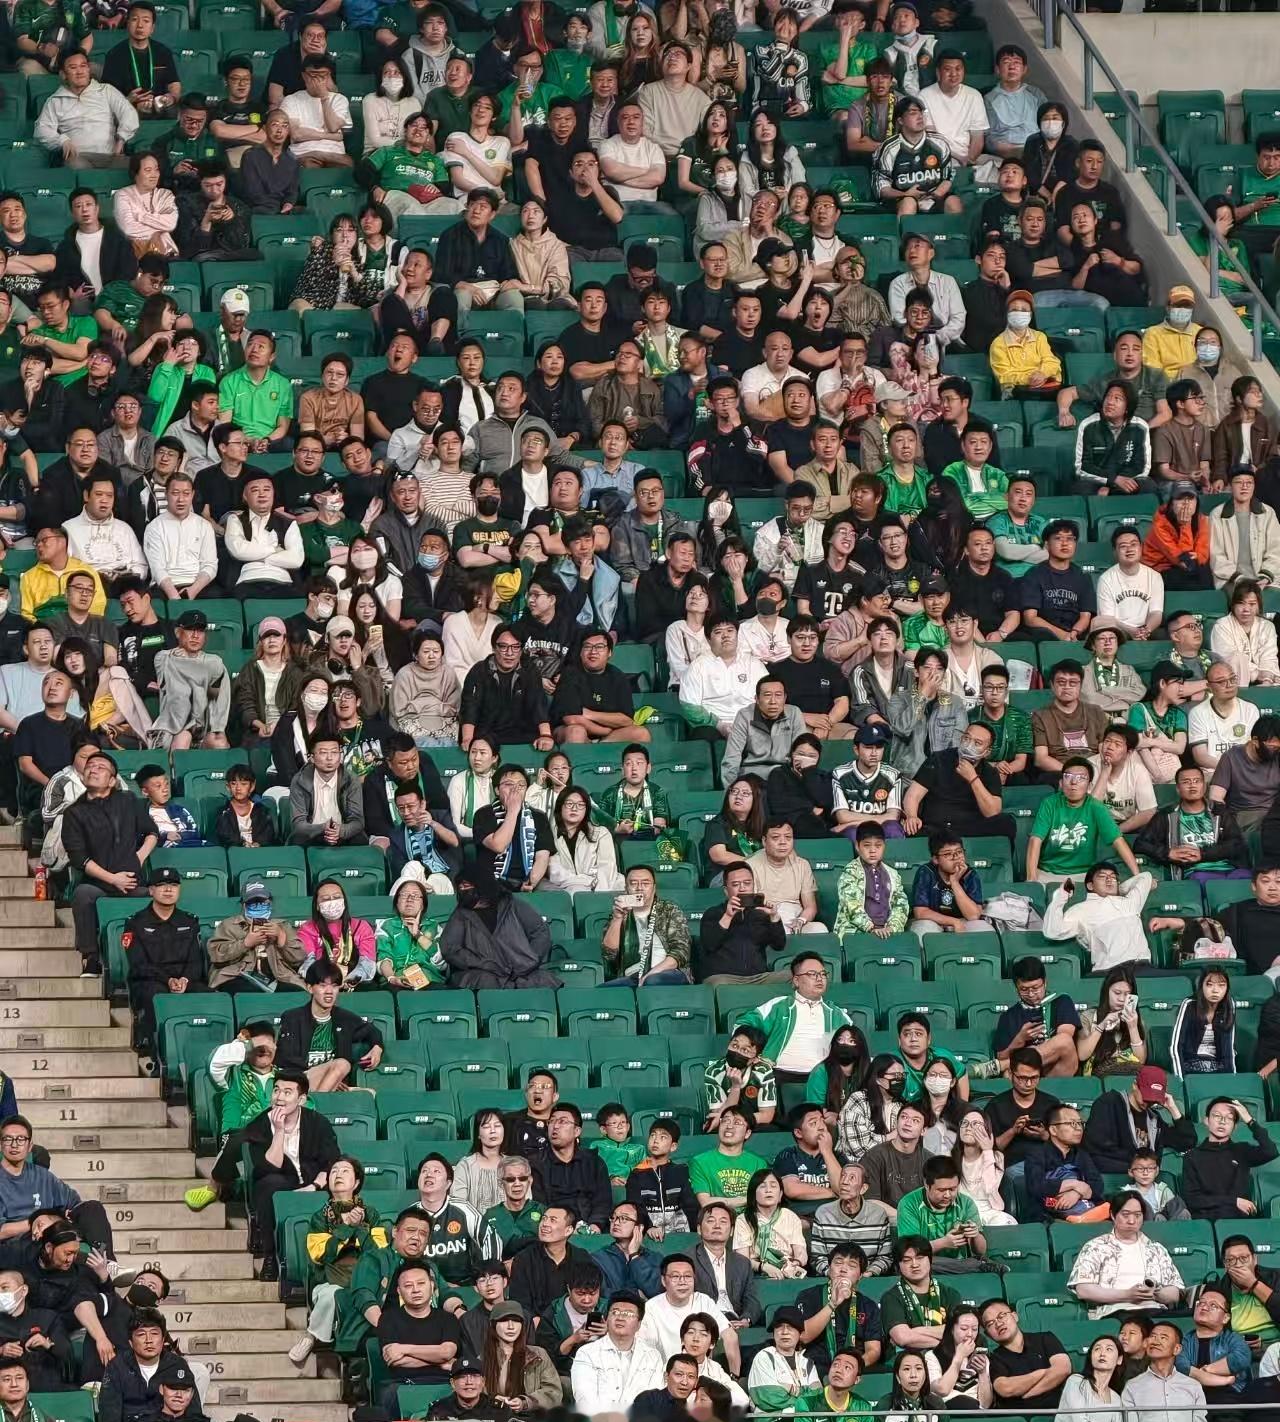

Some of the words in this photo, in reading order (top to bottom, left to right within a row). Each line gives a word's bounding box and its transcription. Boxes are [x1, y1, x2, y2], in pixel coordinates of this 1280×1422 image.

[897, 169, 941, 184] GUOAN
[3, 1007, 20, 1019] 13
[32, 1059, 48, 1071] 12
[59, 1109, 78, 1121] 11
[87, 1160, 105, 1172] 10
[115, 1210, 134, 1222] 09
[143, 1261, 161, 1272] 08
[175, 1311, 192, 1323] 07
[206, 1362, 224, 1374] 06
